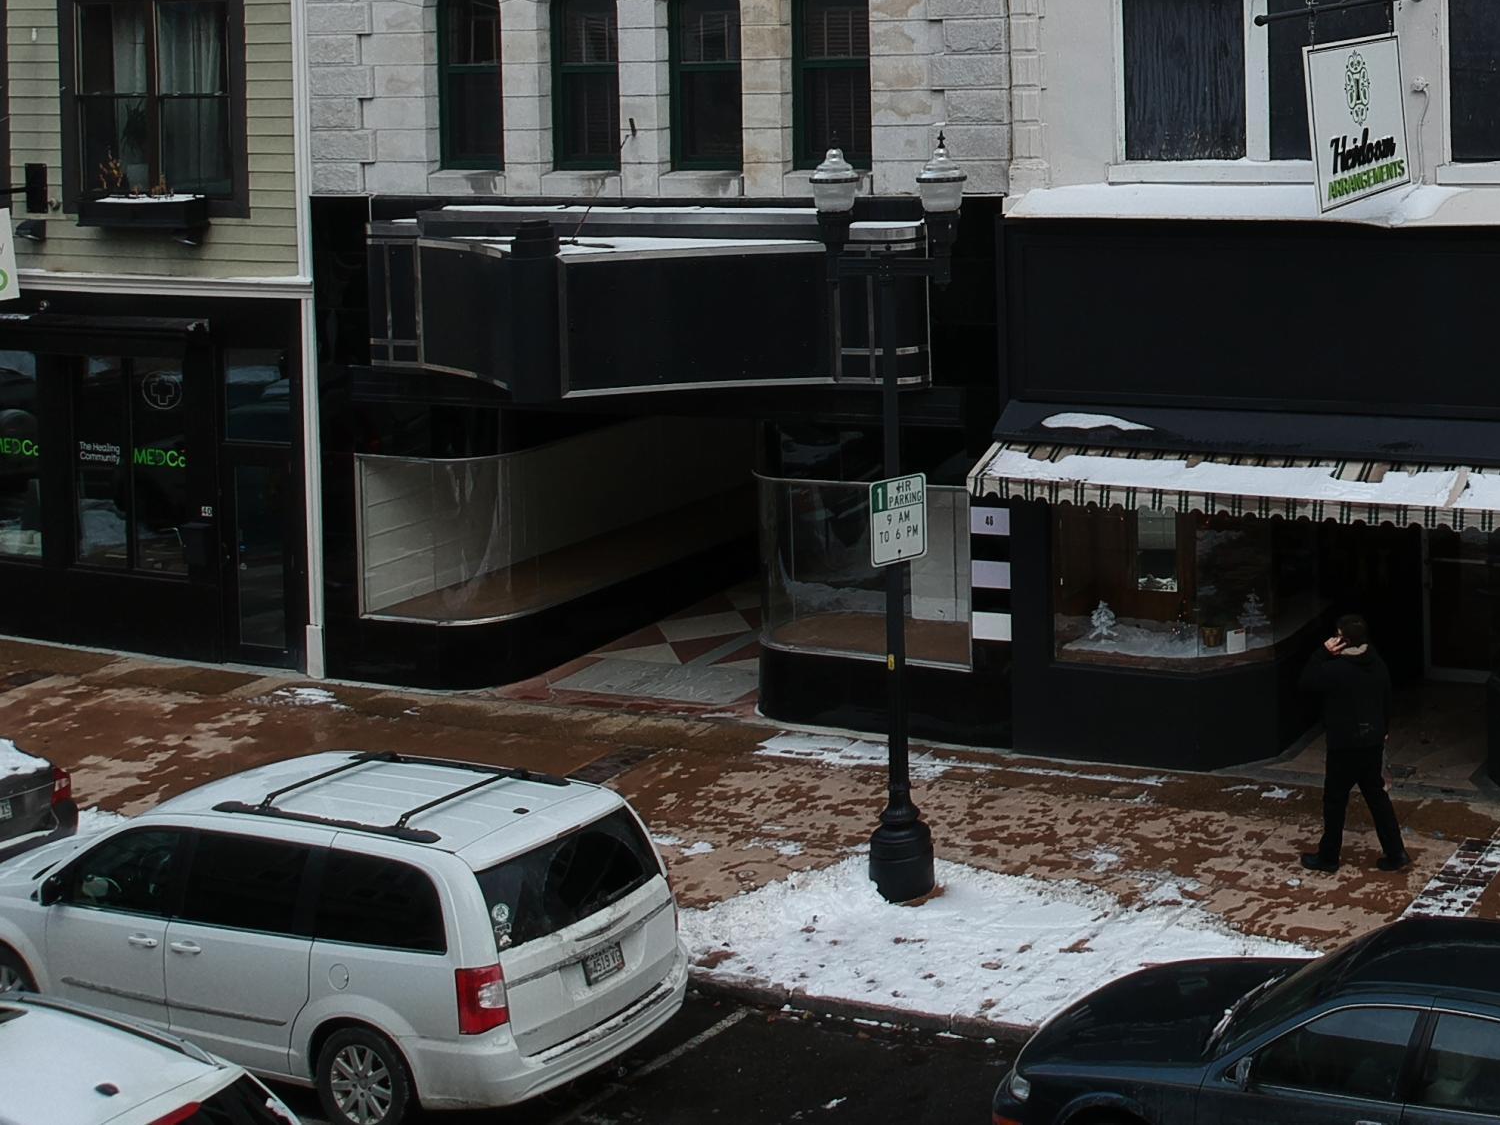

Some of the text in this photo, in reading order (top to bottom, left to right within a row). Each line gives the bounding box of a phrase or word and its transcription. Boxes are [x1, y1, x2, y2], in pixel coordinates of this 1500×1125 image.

[1328, 159, 1405, 201] ARRANGEMENTS
[80, 451, 120, 465] Community
[876, 480, 911, 510] 1 HR
[889, 490, 922, 507] PARKING
[887, 510, 910, 525] 9 AM
[880, 524, 918, 544] TO 6 PM
